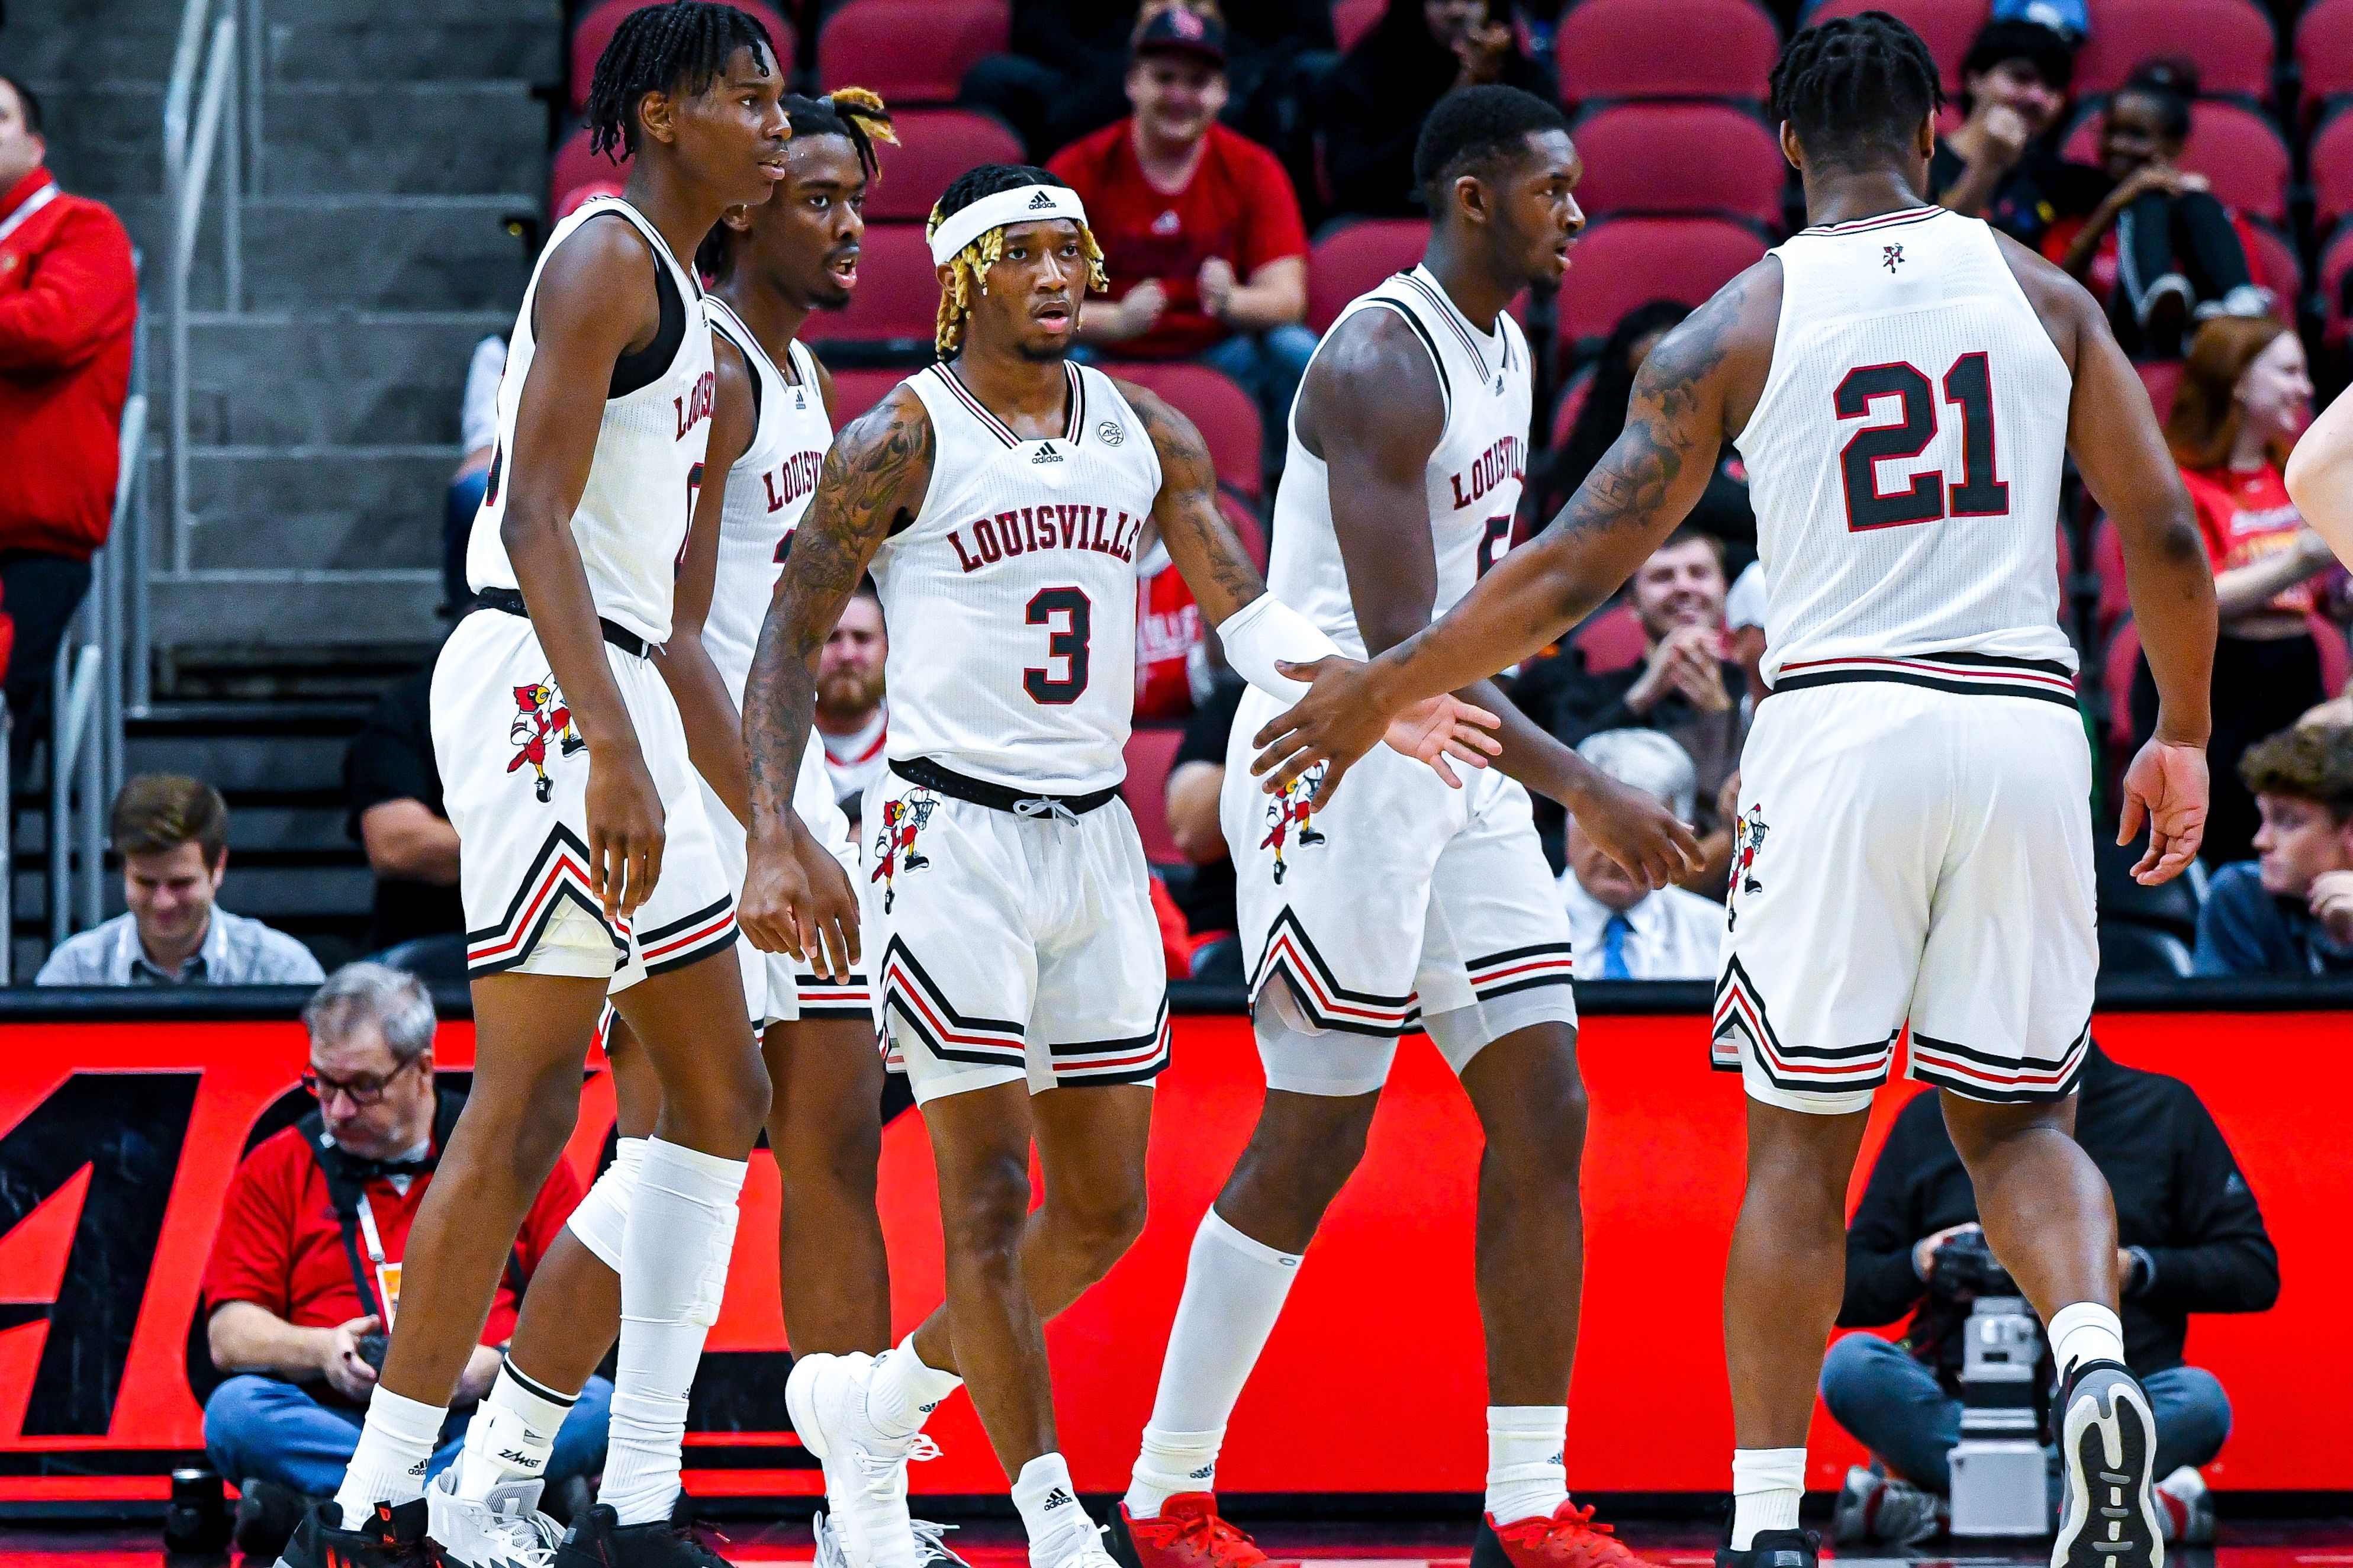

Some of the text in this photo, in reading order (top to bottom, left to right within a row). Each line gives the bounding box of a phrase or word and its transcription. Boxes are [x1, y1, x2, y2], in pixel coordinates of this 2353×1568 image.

[1028, 201, 1057, 210] adidas
[1833, 351, 2010, 532] 21
[1032, 455, 1064, 464] adidas
[1023, 586, 1091, 705] 3
[1044, 1496, 1073, 1511] adidas
